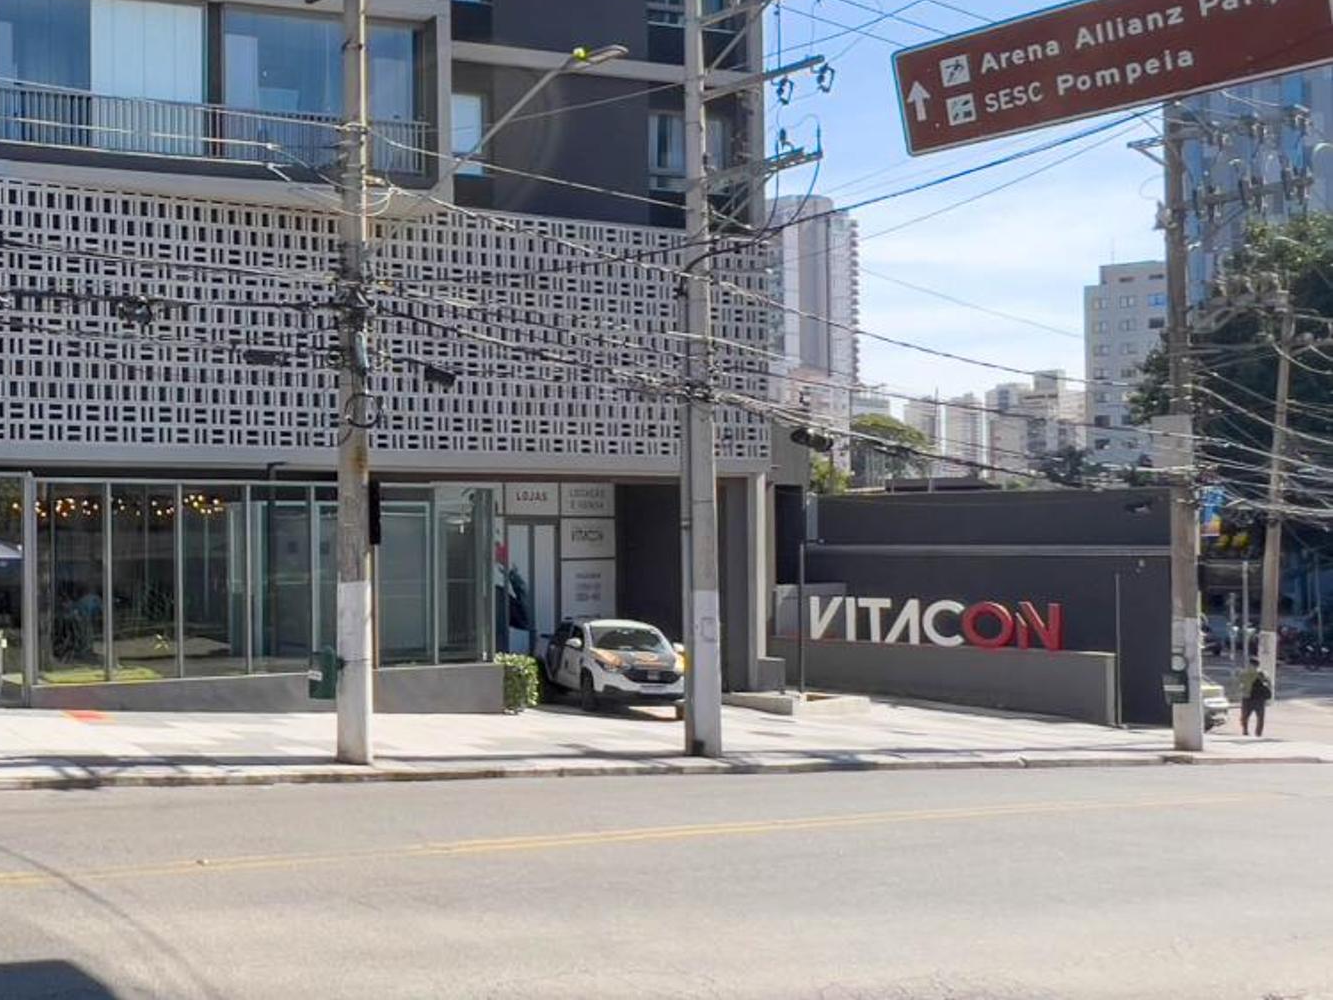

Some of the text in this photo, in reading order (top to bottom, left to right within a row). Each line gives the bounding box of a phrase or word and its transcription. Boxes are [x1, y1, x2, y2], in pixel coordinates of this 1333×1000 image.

[980, 38, 1060, 73] Arena
[1075, 6, 1184, 50] Allianz
[985, 50, 1194, 113] SESC Pompeia
[516, 490, 548, 501] LOJAS
[809, 595, 1063, 652] VITACON
